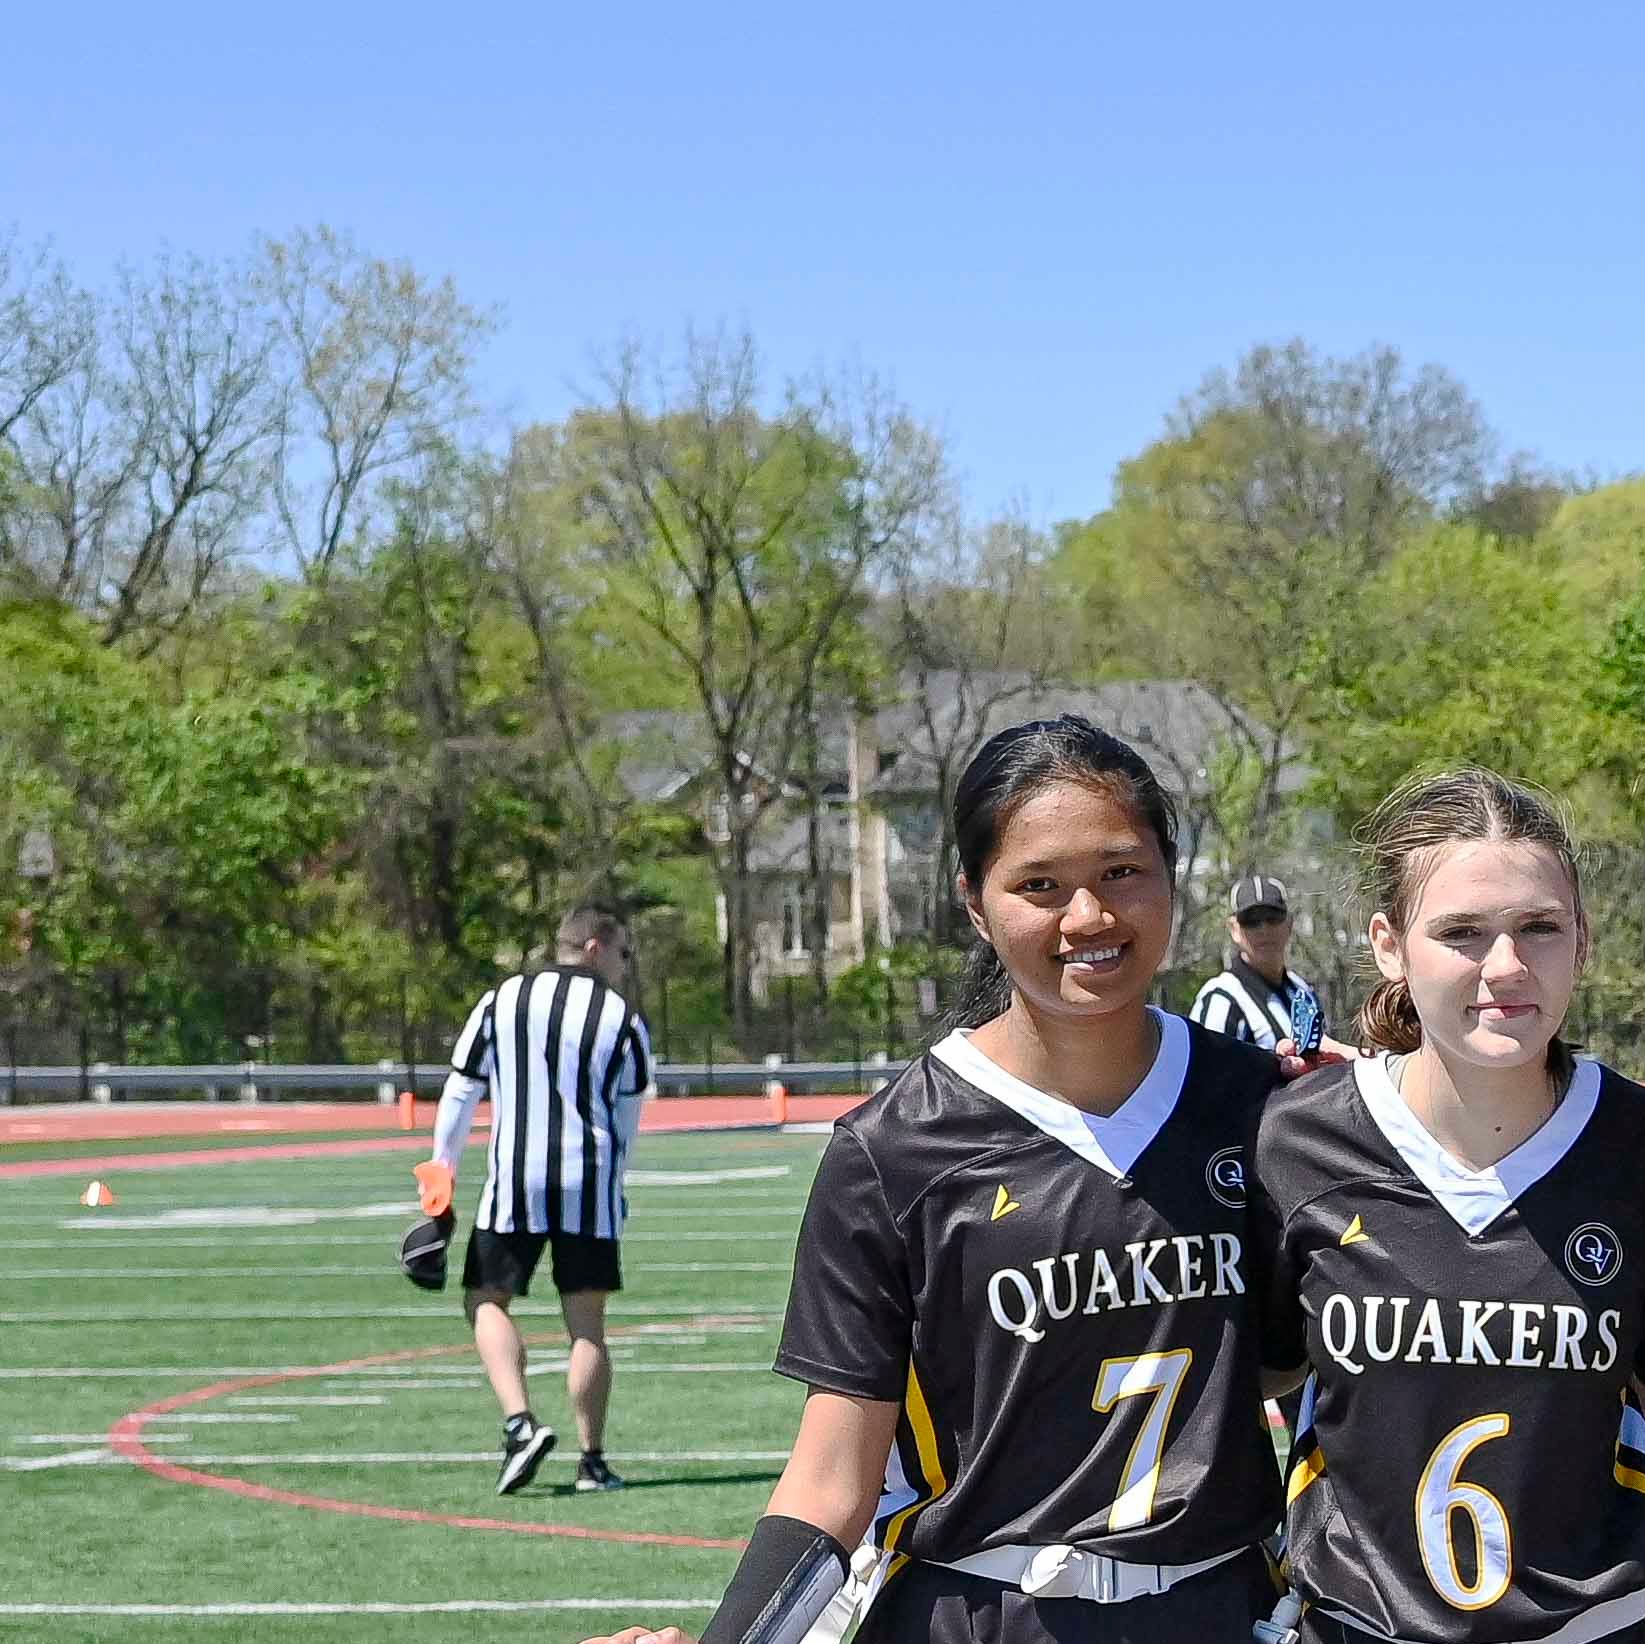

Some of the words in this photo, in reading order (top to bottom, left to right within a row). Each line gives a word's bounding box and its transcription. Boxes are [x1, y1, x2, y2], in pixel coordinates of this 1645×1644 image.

[987, 1232, 1246, 1344] QUAKER
[1321, 1293, 1621, 1374] QUAKERS
[1092, 1348, 1192, 1533] 7
[1415, 1413, 1514, 1611] 6
